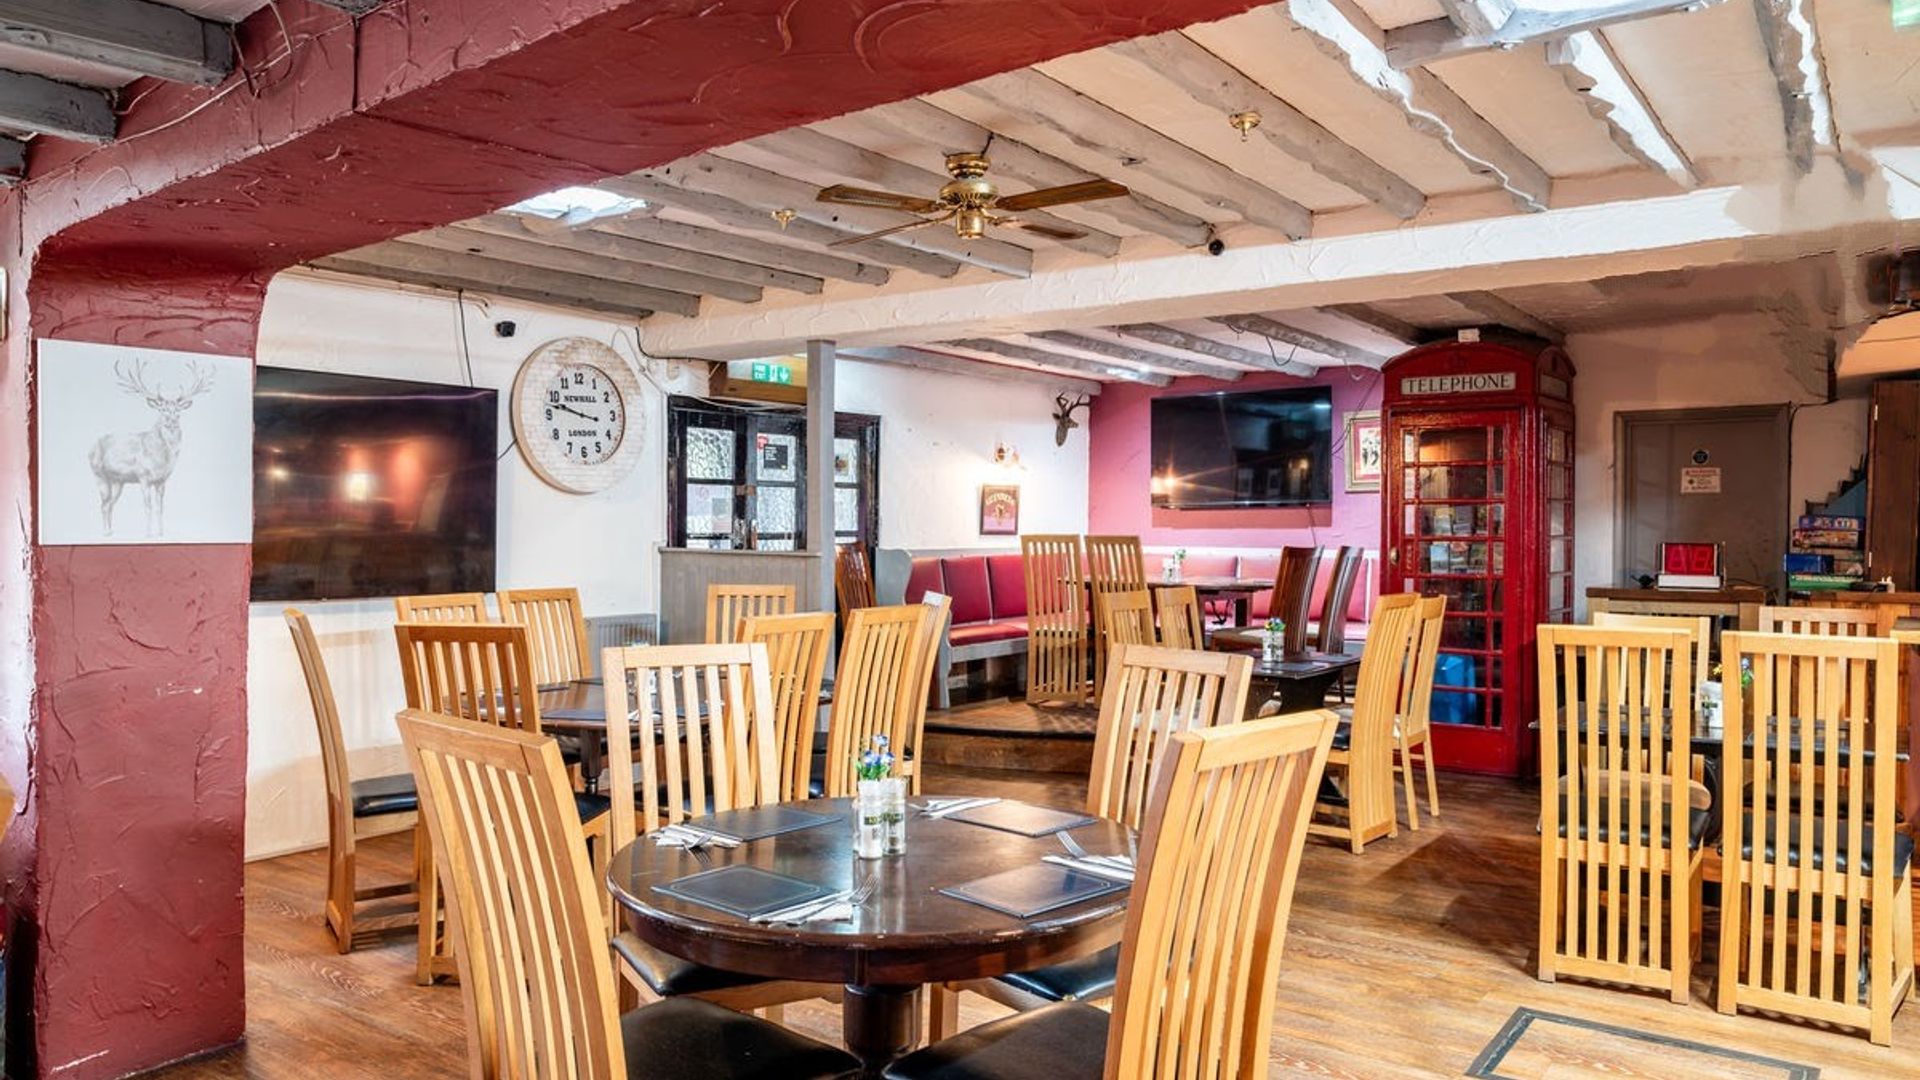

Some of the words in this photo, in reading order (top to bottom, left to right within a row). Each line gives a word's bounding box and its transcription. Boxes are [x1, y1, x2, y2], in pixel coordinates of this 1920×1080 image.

[560, 377, 569, 390] 11
[574, 373, 584, 385] 12
[592, 378, 597, 390] 1
[1408, 374, 1511, 393] TELEPHONE
[550, 390, 560, 403] 10
[564, 395, 597, 403] NEWHALL
[603, 391, 610, 403] 2
[545, 408, 553, 421] 9
[610, 410, 616, 422] 3
[552, 428, 560, 440] 8
[568, 429, 597, 437] LONDON
[605, 429, 611, 441] 4
[566, 442, 573, 454] 7
[580, 446, 588, 458] 6
[595, 441, 601, 454] 5
